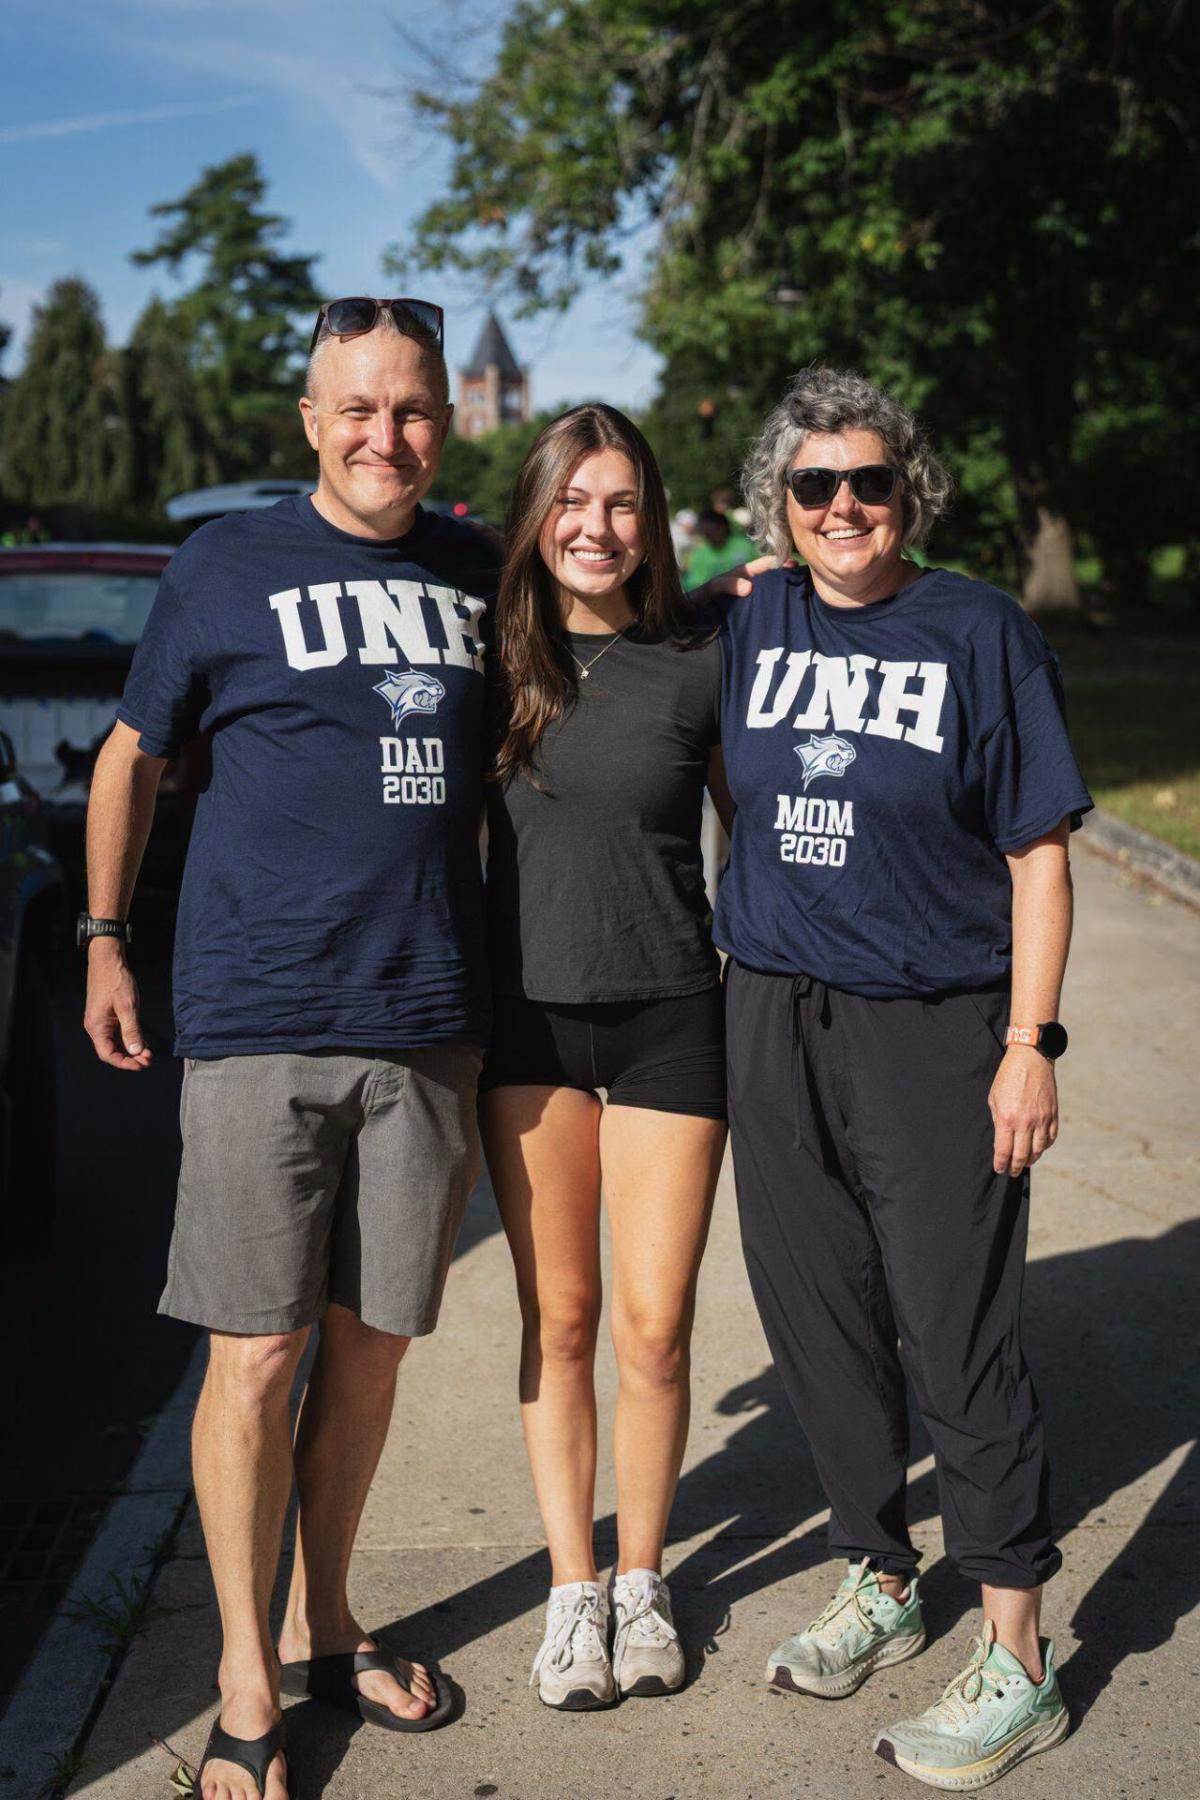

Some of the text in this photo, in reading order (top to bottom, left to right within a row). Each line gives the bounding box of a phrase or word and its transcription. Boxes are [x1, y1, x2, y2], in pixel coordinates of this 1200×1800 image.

[269, 579, 487, 676] UNH
[746, 647, 948, 754] UNH
[379, 736, 445, 774] DAD
[383, 776, 446, 805] 2030
[773, 794, 855, 837] MOM
[780, 833, 847, 868] 2030
